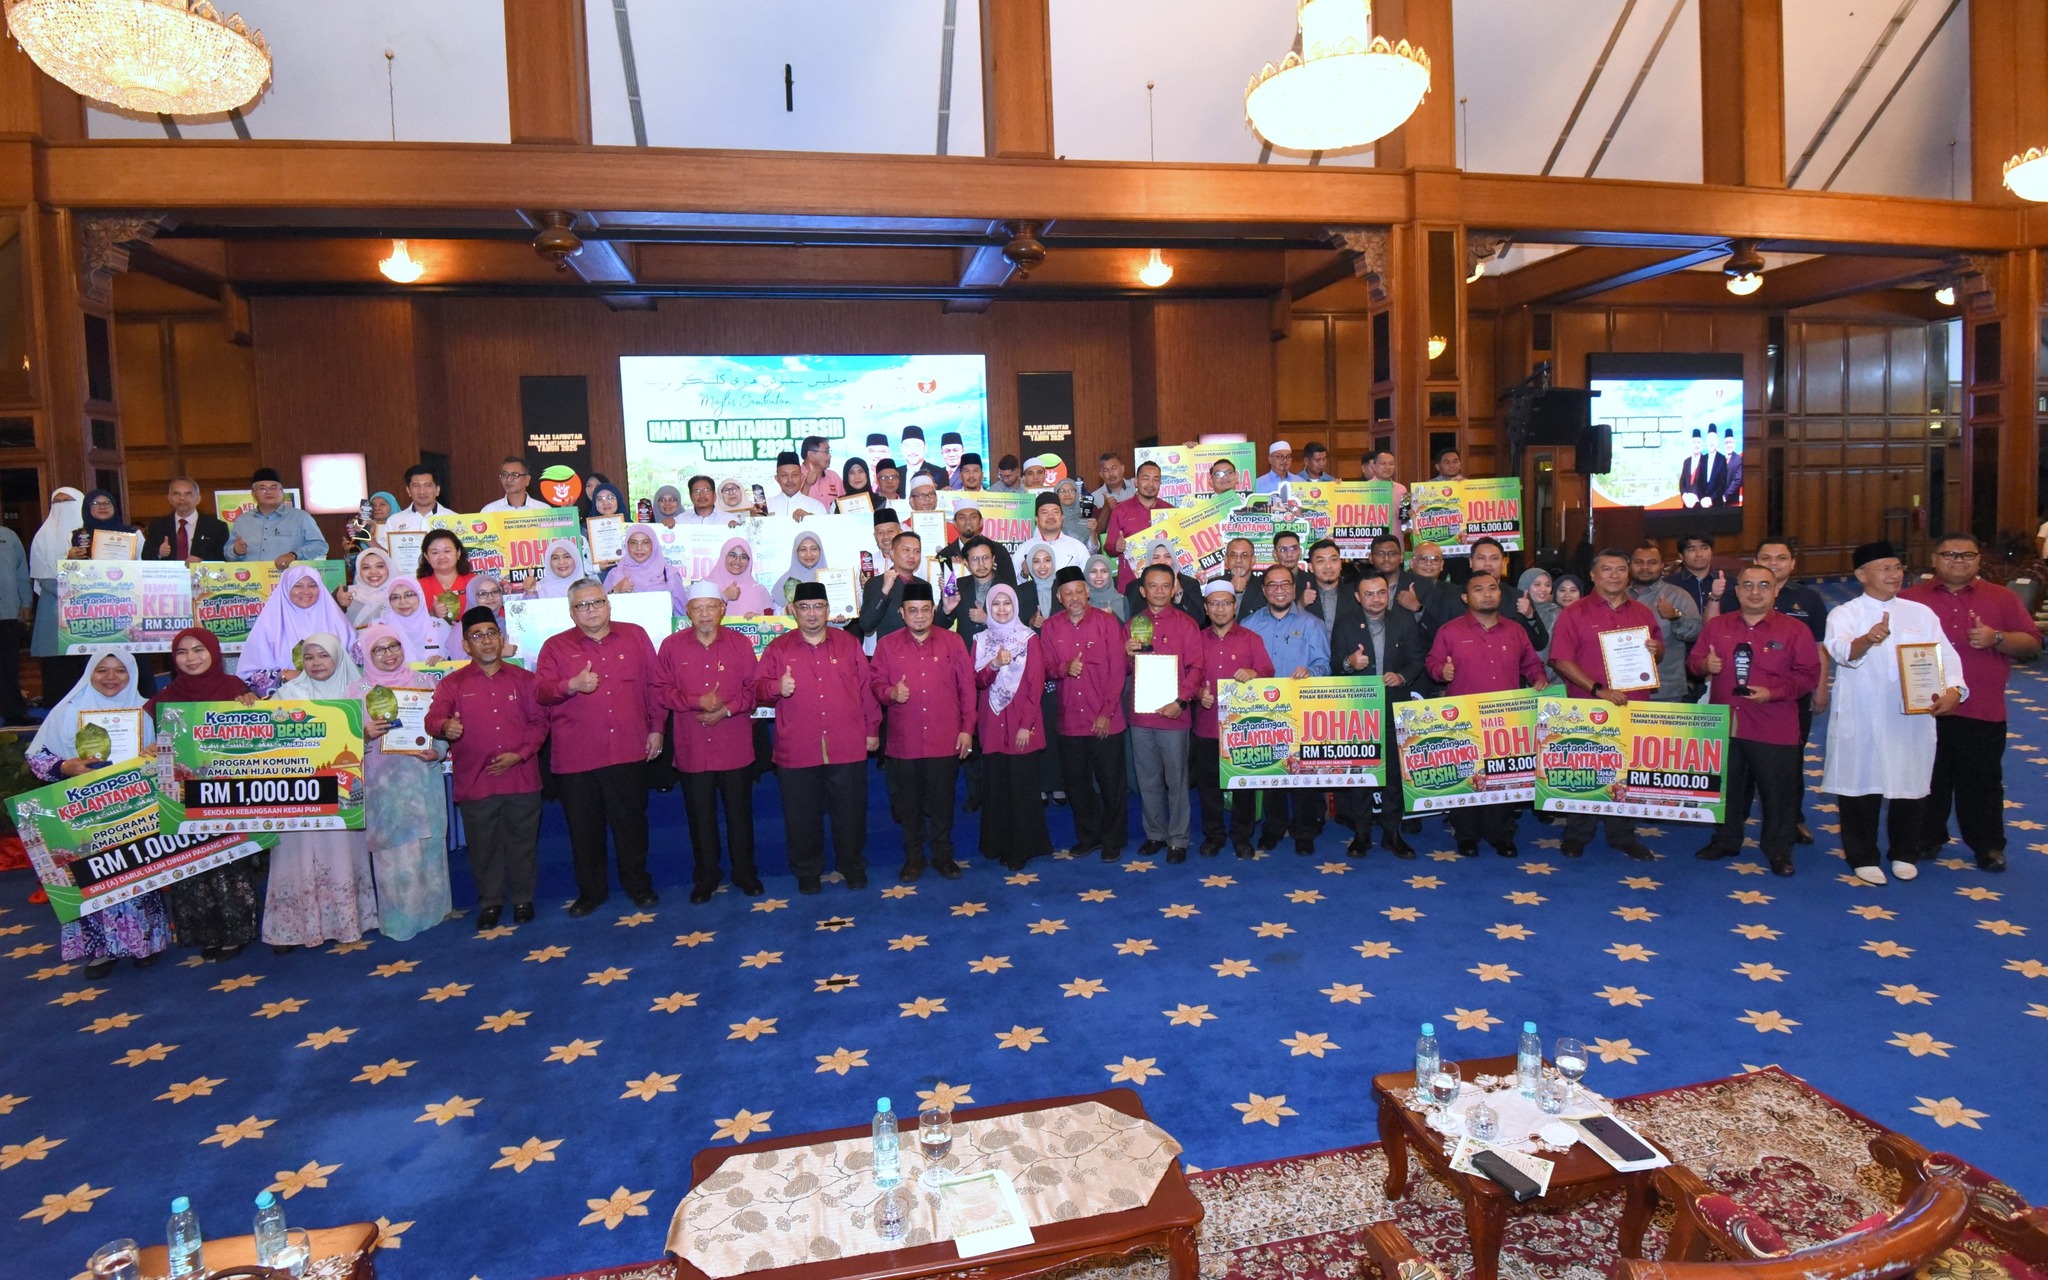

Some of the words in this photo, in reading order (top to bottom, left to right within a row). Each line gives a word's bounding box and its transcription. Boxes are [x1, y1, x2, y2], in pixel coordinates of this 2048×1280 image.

[700, 392, 736, 417] Majlis
[739, 391, 793, 408] Sambutan
[650, 421, 687, 440] HARI
[690, 419, 787, 440] KELANTANKU
[790, 418, 844, 439] BERSIH
[704, 440, 753, 461] TAHUN
[756, 439, 794, 460] 2025
[1161, 477, 1187, 485] ndingan
[1195, 469, 1252, 493] KEA
[1230, 514, 1270, 522] Kempen
[1335, 504, 1388, 526] JOHAN
[1467, 500, 1518, 522] JOHAN
[984, 518, 1031, 541] OHAN
[1221, 523, 1273, 533] KELANTANKU
[1275, 524, 1307, 533] BERSIH
[1417, 514, 1463, 528] KELANTANKU
[1468, 524, 1480, 532] RM
[1481, 522, 1513, 532] 5,000.00
[1190, 523, 1223, 558] JOH
[1335, 528, 1347, 537] RM
[1349, 528, 1382, 537] 5,000.00
[1421, 527, 1449, 540] BERSIH
[468, 550, 497, 559] ndingan
[1201, 555, 1217, 570] RM
[471, 556, 504, 571] NTANKU
[512, 570, 527, 582] RM
[144, 584, 177, 592] TEMPAT
[70, 595, 131, 605] Pertandingan
[142, 594, 190, 616] KETI
[203, 596, 260, 606] Pertandingan
[64, 602, 137, 619] KELANTANKU
[70, 618, 114, 634] BERSIH
[145, 618, 162, 629] RM
[165, 618, 193, 631] 3,000
[204, 618, 246, 634] BERSIH
[726, 625, 756, 634] mpen
[206, 712, 269, 724] Kempen
[1231, 721, 1287, 731] Pertandingan
[1300, 709, 1380, 742] JOHAN
[1481, 717, 1504, 727] NAIB
[194, 724, 273, 740] KELANTANKU
[277, 722, 326, 739] BERSIH
[1227, 728, 1293, 748] KELANTANKU
[1409, 739, 1470, 754] Pertandingan
[1483, 726, 1537, 758] JOH
[1549, 743, 1616, 753] Pertandingan
[1232, 746, 1272, 766] BERSIH
[1303, 746, 1320, 758] RM
[1322, 745, 1375, 759] 15,000.00
[1406, 746, 1478, 770] KELANTANKU
[1629, 735, 1722, 773] JOHAN
[213, 759, 262, 767] PROGRAM
[263, 757, 309, 766] KOMUNITI
[281, 766, 315, 775] (PKAH)
[1488, 759, 1506, 773] RM
[1508, 757, 1536, 772] 3,00
[1543, 753, 1622, 771] KELANTANKU
[1413, 765, 1457, 788] BERSIH
[1548, 770, 1595, 788] BERSIH
[1630, 771, 1650, 785] RM
[1653, 773, 1709, 789] 5,000.00
[66, 772, 139, 802] Kempen
[200, 781, 231, 804] RM
[236, 779, 320, 805] 1,000.00
[57, 781, 150, 821] KELANTANKU
[91, 829, 137, 851] AMALAN
[139, 822, 159, 834] HIJA
[93, 817, 146, 840] PROGRAM
[88, 848, 128, 879] RM
[90, 883, 105, 894] SRU
[106, 879, 119, 889] (A)
[119, 870, 145, 882] DARUL
[145, 862, 166, 874] ULUM
[166, 853, 192, 867] DINIAH
[192, 843, 222, 856] PADANG
[223, 835, 240, 846] SIAM
